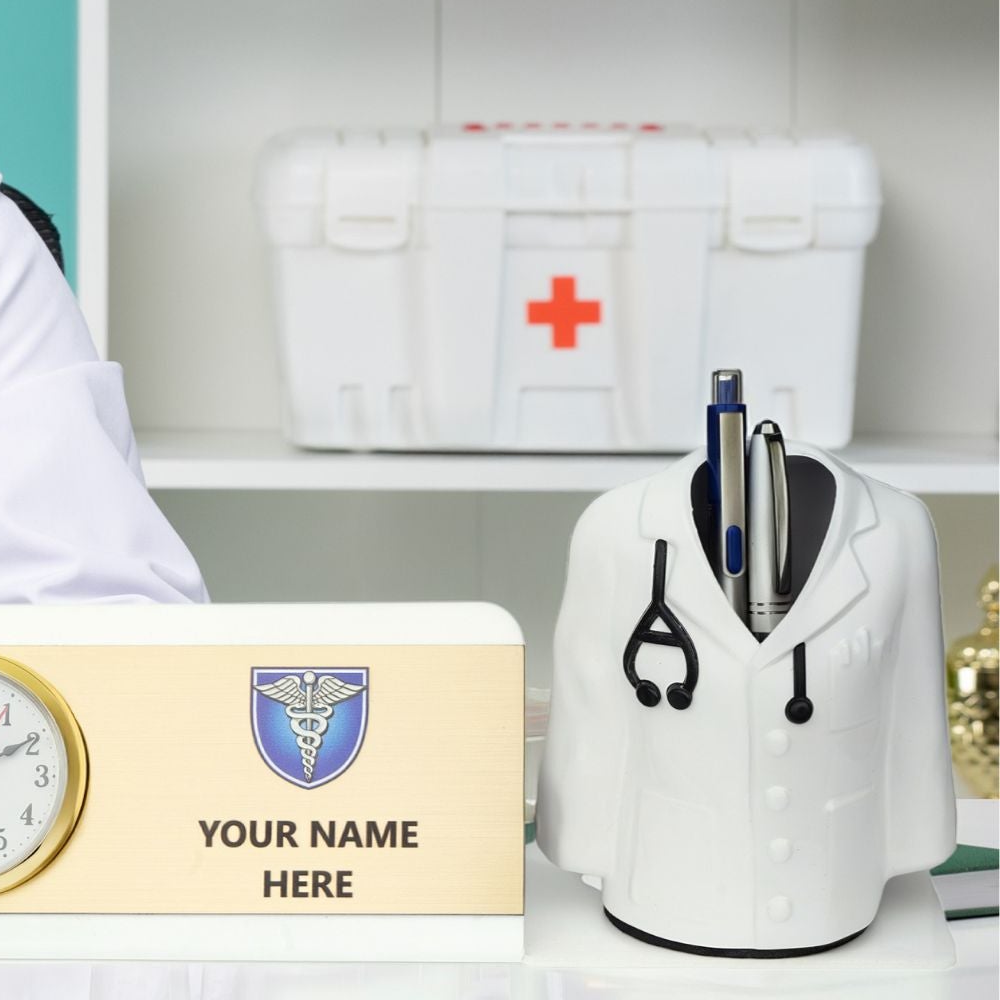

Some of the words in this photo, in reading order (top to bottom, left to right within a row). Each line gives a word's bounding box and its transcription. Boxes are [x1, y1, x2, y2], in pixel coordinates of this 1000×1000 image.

[2, 703, 12, 726] 1
[25, 732, 40, 755] 2
[34, 765, 49, 787] 3
[20, 803, 34, 826] 4
[198, 820, 299, 848] YOUR
[310, 820, 419, 848] NAME
[263, 870, 353, 898] HERE
